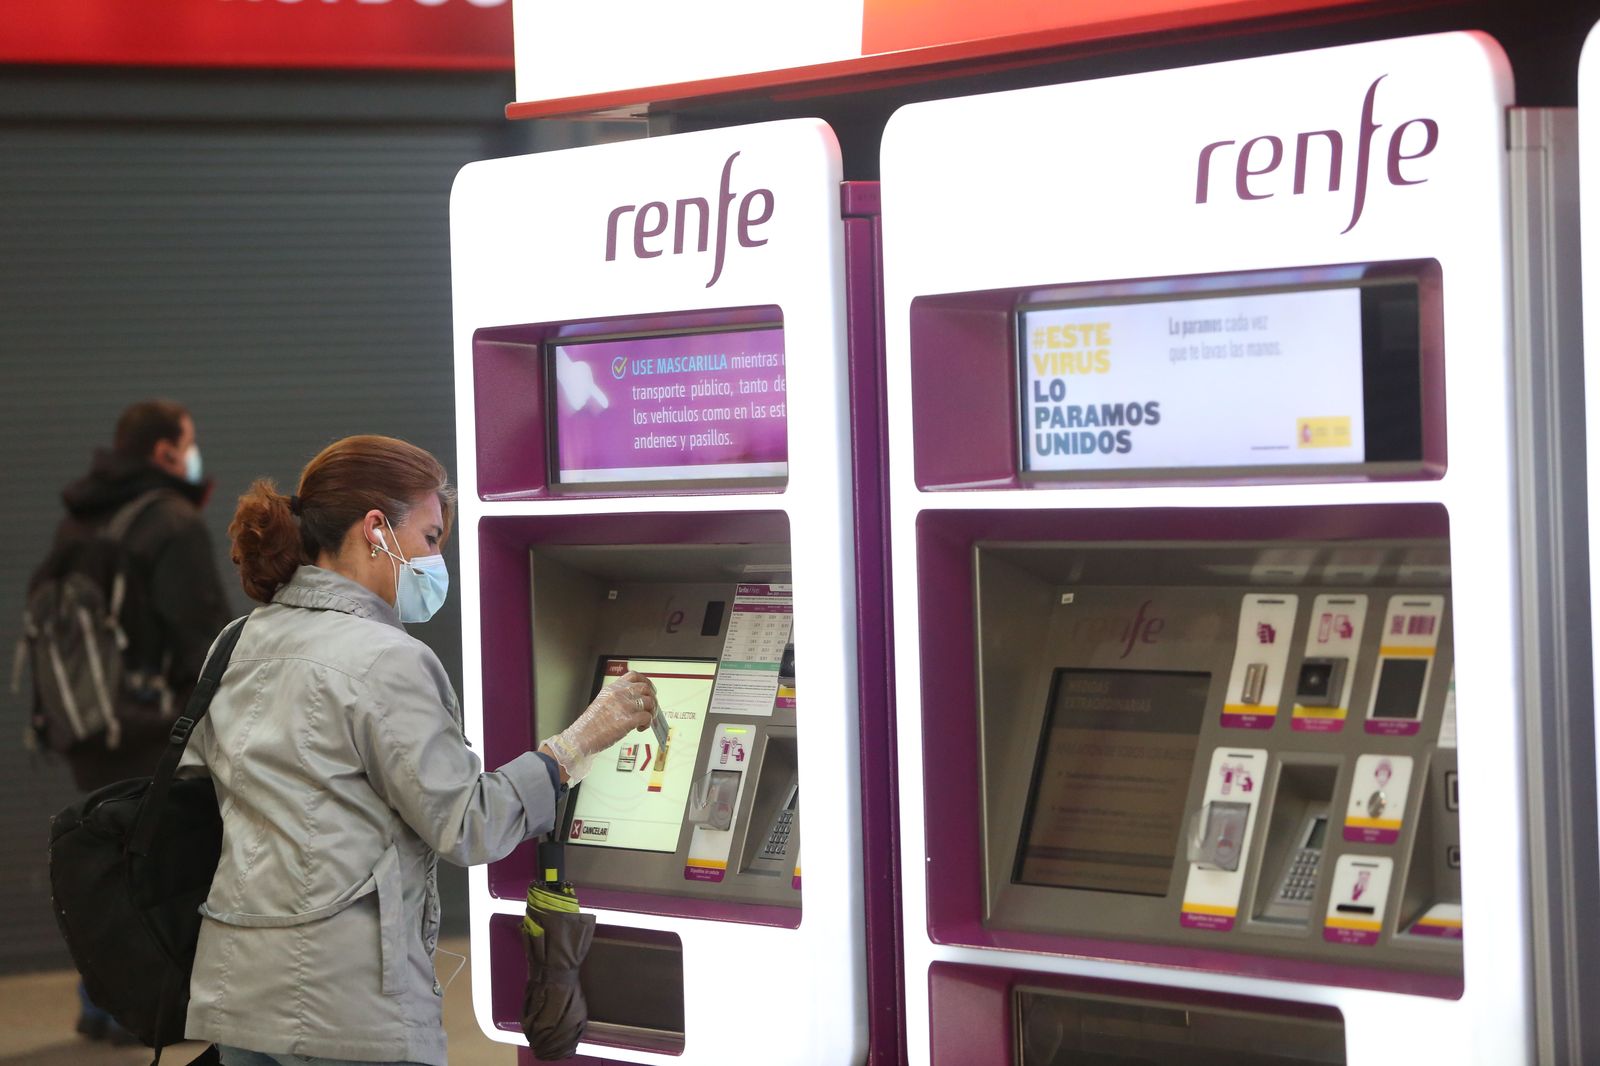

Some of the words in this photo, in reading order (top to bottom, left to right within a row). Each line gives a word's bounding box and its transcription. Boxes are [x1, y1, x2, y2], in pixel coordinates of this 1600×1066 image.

[1195, 73, 1439, 235] renfe
[605, 150, 774, 288] renfe
[1032, 323, 1111, 350] #ESTE
[1182, 318, 1222, 339] paramos
[632, 359, 653, 375] USE
[657, 354, 727, 374] MASCARILLA
[731, 352, 778, 369] mientras
[1032, 350, 1111, 376] VIRUS
[632, 384, 686, 402] transporte
[691, 379, 734, 401] público,
[739, 378, 768, 394] tanto
[1034, 378, 1066, 403] LO
[633, 409, 648, 425] los
[651, 406, 699, 423] vehículos
[702, 408, 731, 422] como
[734, 407, 747, 419] en
[751, 404, 766, 419] las
[1034, 401, 1161, 430] PARAMOS
[634, 432, 677, 450] andenes
[680, 435, 686, 451] y
[690, 429, 733, 451] pasillos.
[1035, 429, 1133, 456] UNIDOS
[582, 825, 608, 836] CANCELAR
